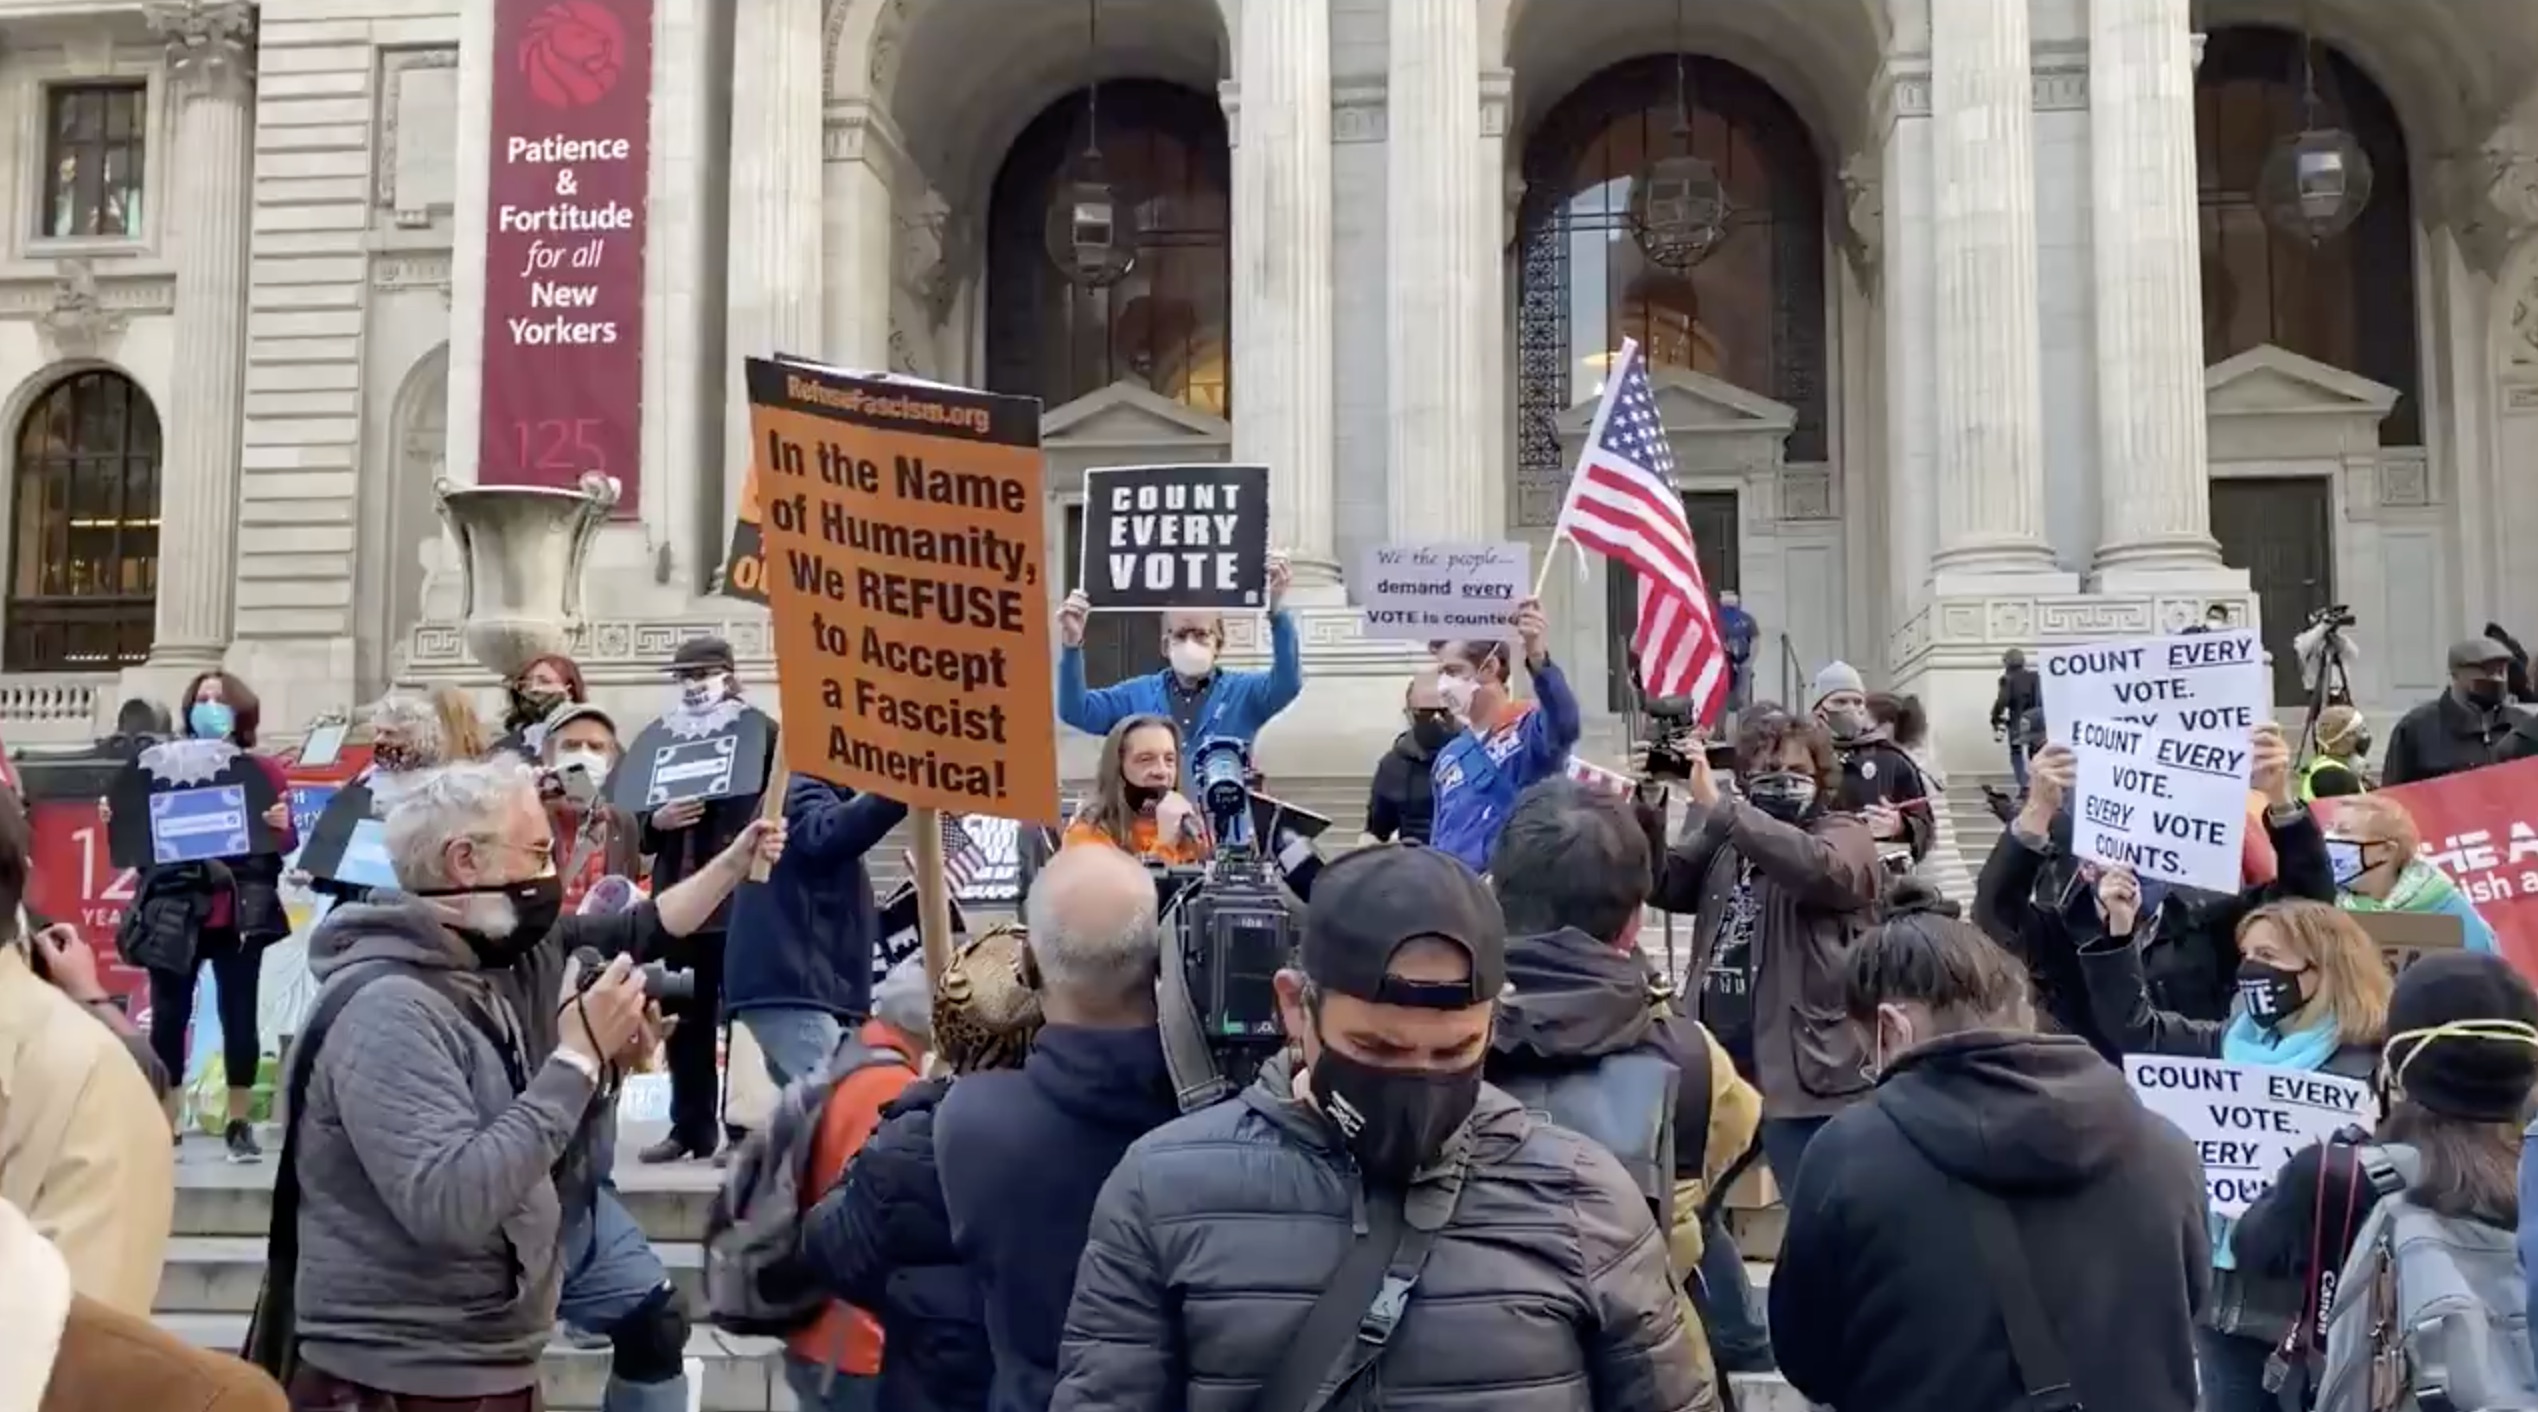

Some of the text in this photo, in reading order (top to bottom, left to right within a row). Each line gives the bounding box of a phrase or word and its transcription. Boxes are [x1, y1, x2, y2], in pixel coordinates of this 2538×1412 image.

[508, 135, 630, 163] Patience
[556, 170, 577, 195] &
[500, 201, 633, 231] Fortitude
[521, 240, 603, 277] for all
[531, 281, 598, 307] New
[508, 317, 618, 345] Yorkers
[787, 374, 989, 433] RefuseFascism.org
[514, 418, 606, 469] 125
[770, 430, 1025, 513] In the Name
[1111, 484, 1240, 512] COUNT
[772, 494, 1037, 586] of Humanity,
[1110, 514, 1239, 547] EVERY
[1109, 553, 1239, 590] VOTE
[1378, 550, 1402, 564] We
[1413, 547, 1438, 565] the
[788, 549, 1024, 634] We REFUSE
[1378, 580, 1513, 599] demand every
[1367, 610, 1419, 624] VOTE
[1424, 610, 1438, 624] is
[812, 612, 1007, 691] to Accept
[2049, 637, 2252, 676] COUNT EVERY
[2114, 678, 2195, 704] VOTE.
[823, 679, 1007, 744] a Fascist
[2179, 706, 2252, 732] VOTE
[828, 725, 1007, 797] America!
[2085, 723, 2142, 755] COUNT
[2157, 738, 2245, 772] EVERY
[2113, 765, 2173, 799] VOTE.
[2085, 794, 2226, 846] EVERY VOTE
[2096, 834, 2187, 875] COUNTS.
[2137, 1065, 2360, 1110] COUNT EVERY
[2209, 1105, 2300, 1134] VOTE.
[2195, 1141, 2259, 1164] ERY
[2317, 1270, 2336, 1335] Canon
